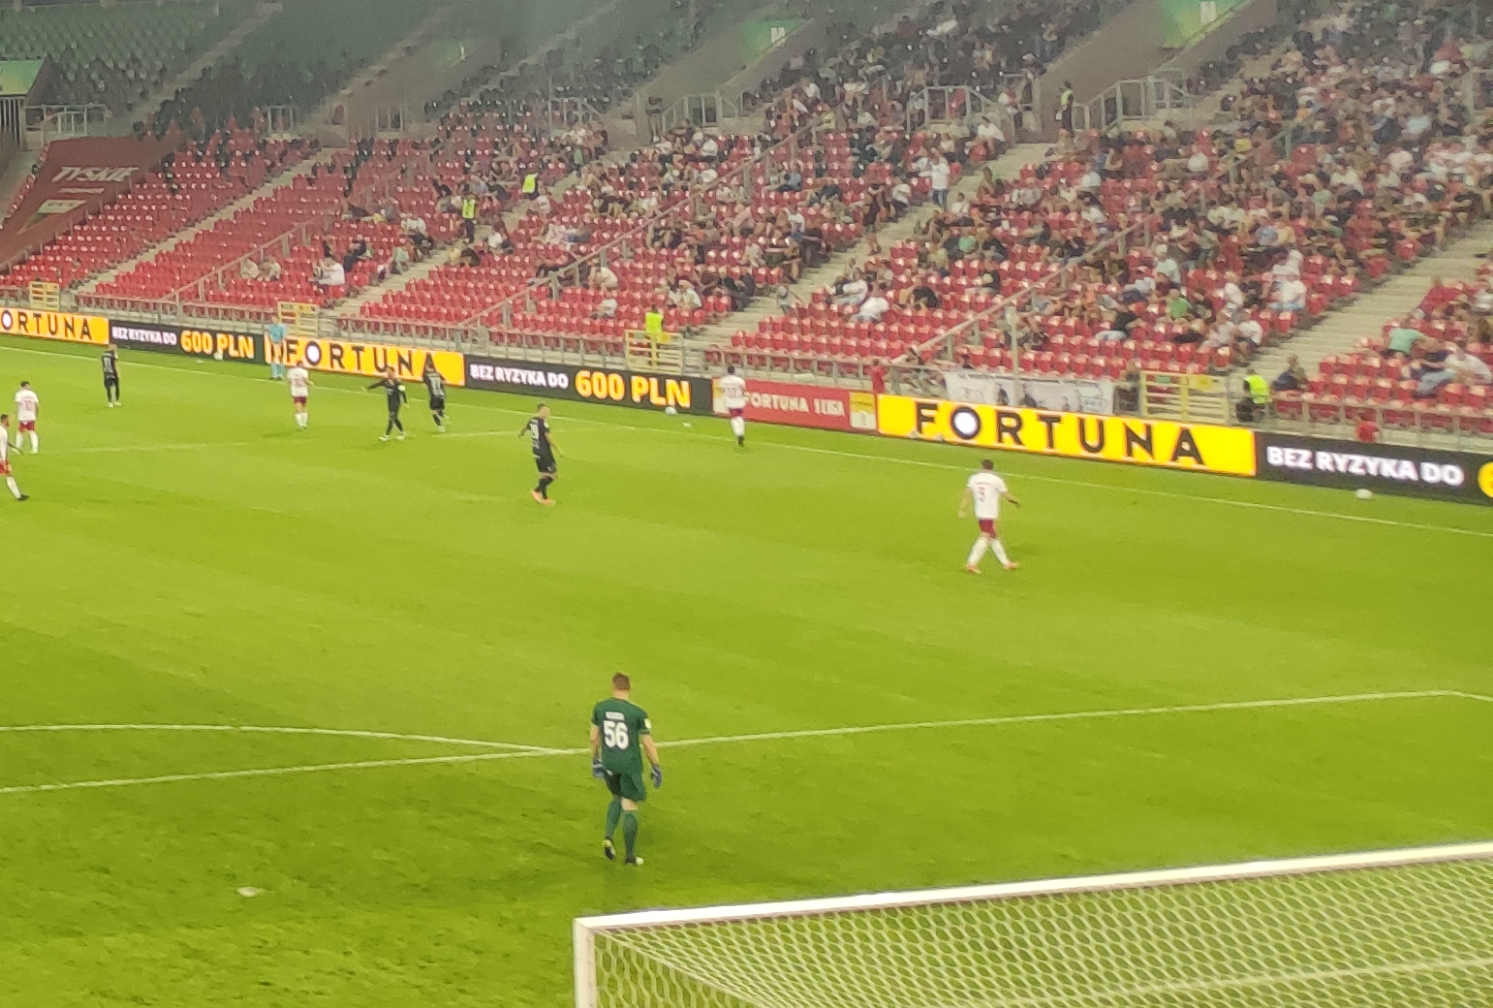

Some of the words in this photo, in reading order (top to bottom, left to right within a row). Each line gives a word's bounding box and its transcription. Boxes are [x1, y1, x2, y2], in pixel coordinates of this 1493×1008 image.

[180, 330, 213, 354] 600
[216, 333, 255, 359] PLN
[469, 364, 494, 380] BEZ
[495, 366, 546, 387] RYZYKA
[547, 373, 569, 389] DO
[575, 370, 625, 400] 600
[631, 375, 691, 409] PLN
[745, 392, 809, 413] ORTUNA
[914, 400, 1207, 466] FORTUNA
[1266, 446, 1312, 470] BEZ
[1316, 451, 1419, 482] RYZYKA
[1420, 462, 1465, 487] DO
[602, 720, 630, 750] 56
